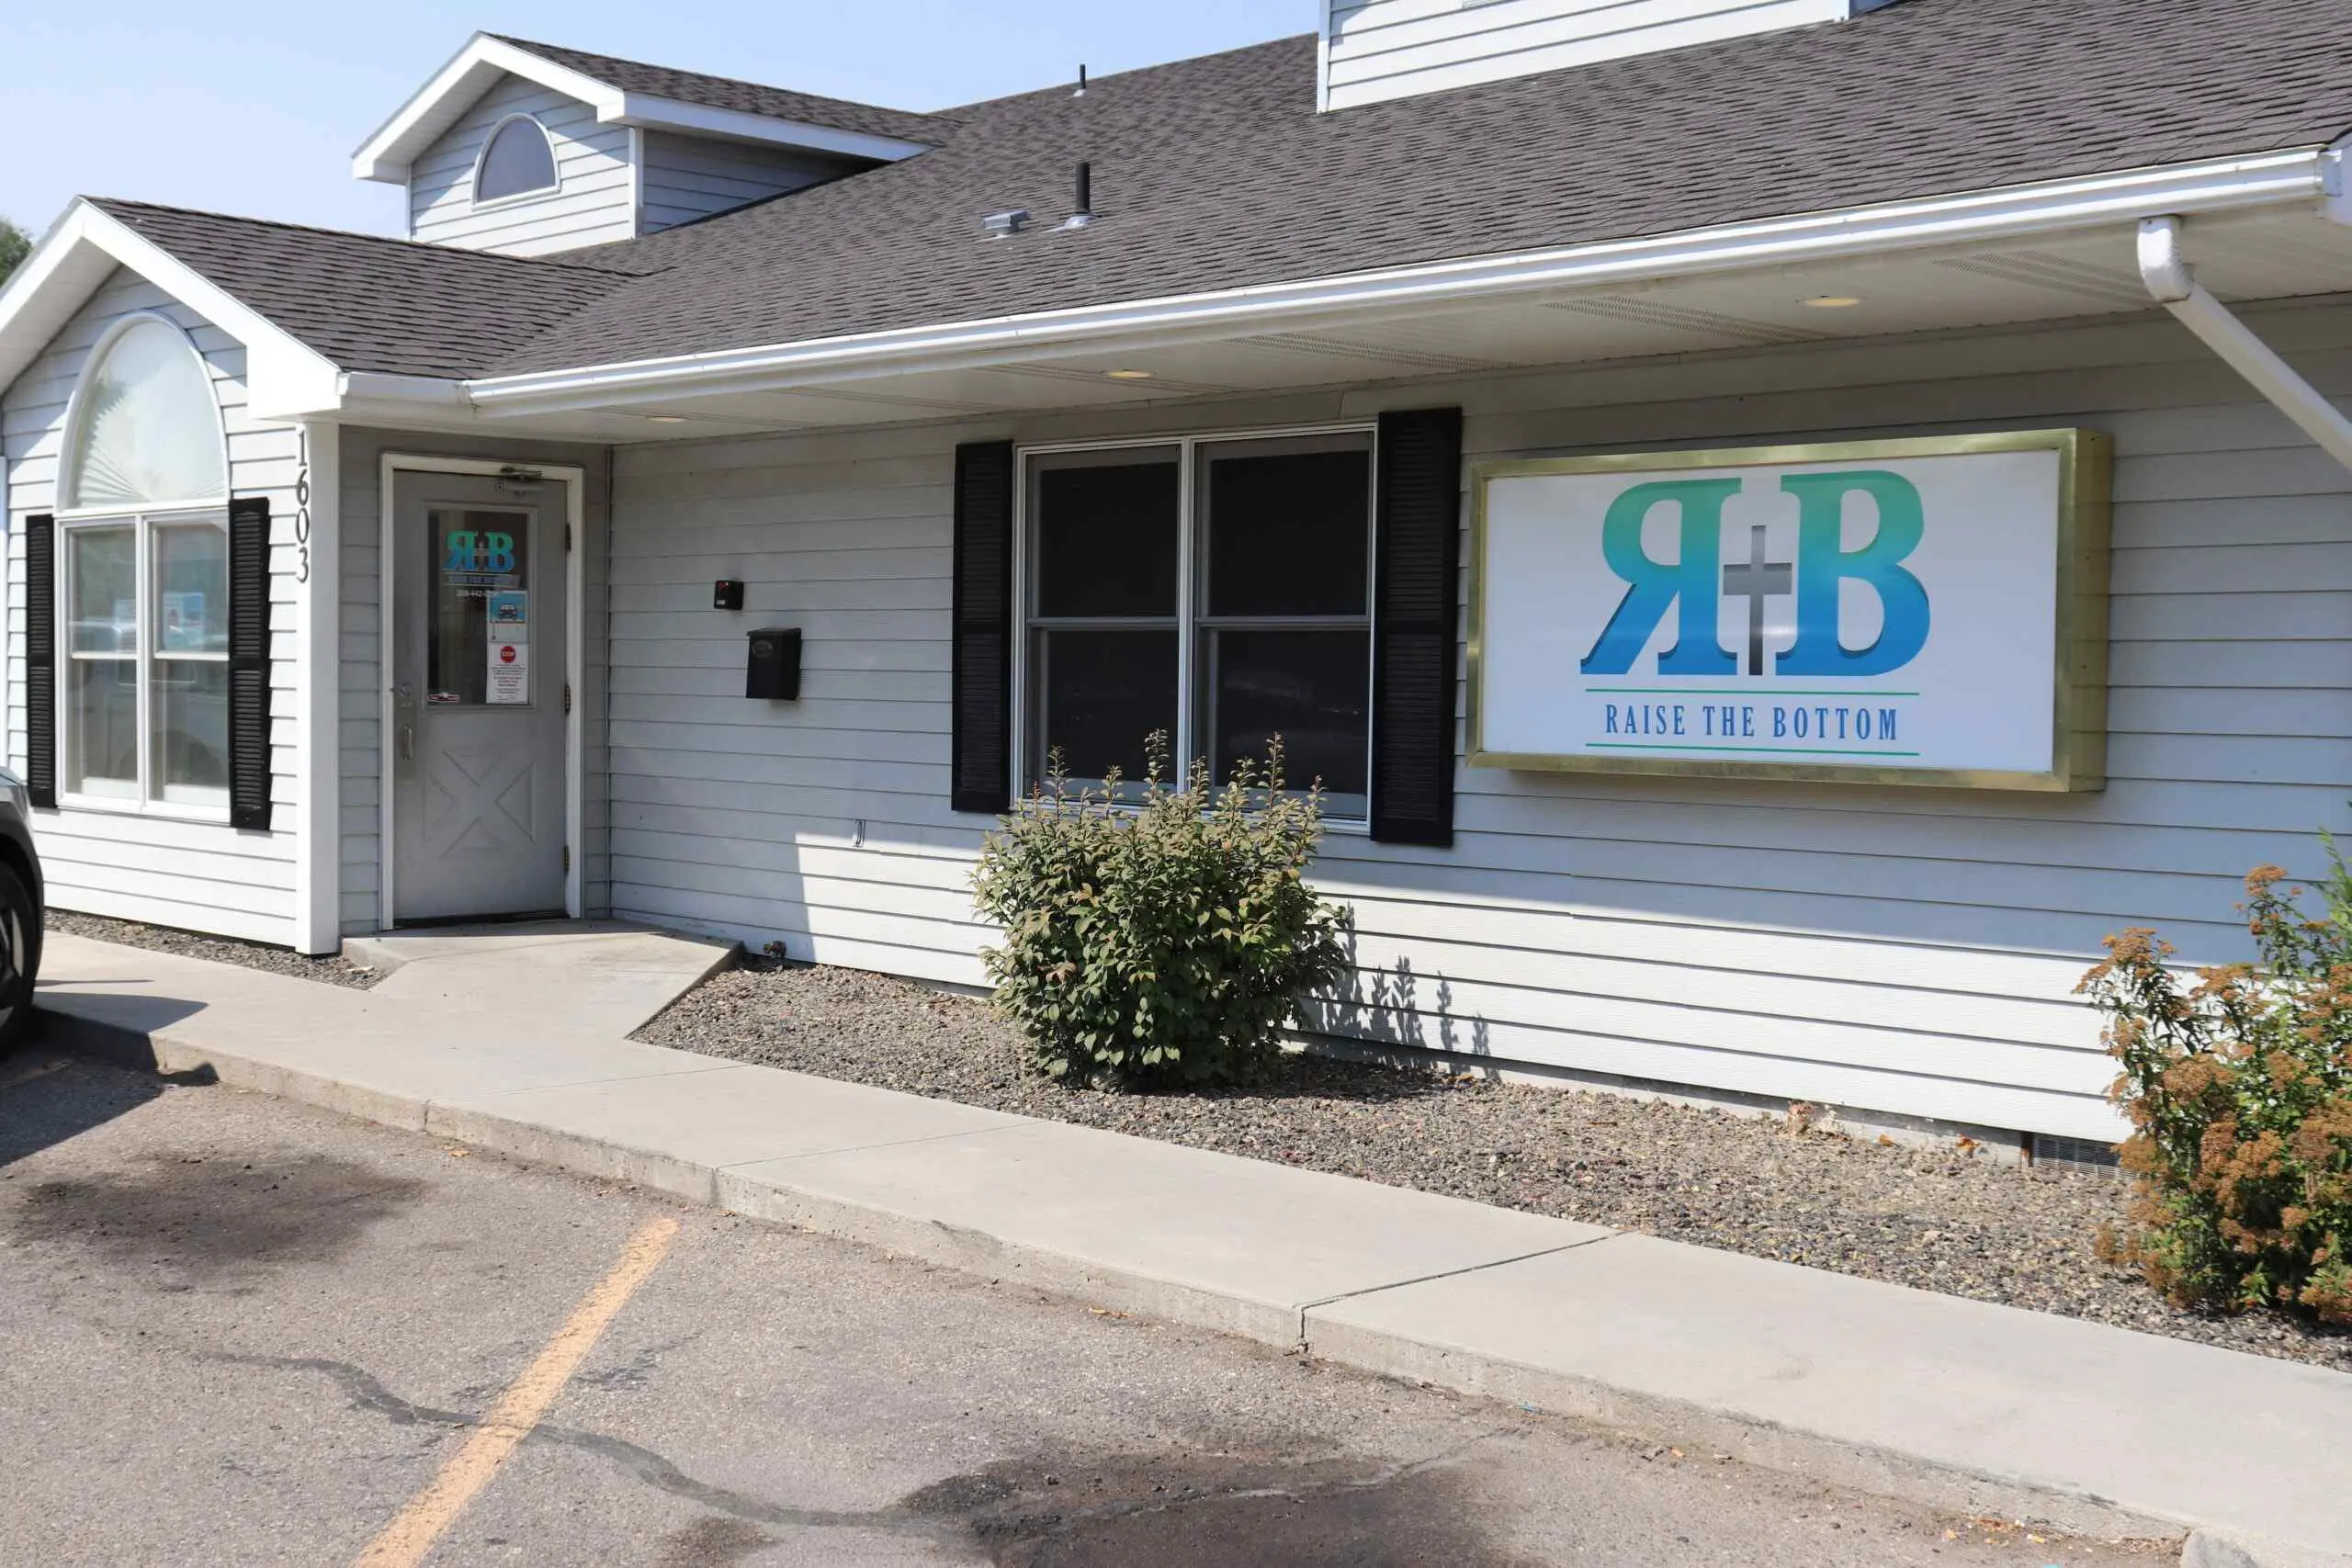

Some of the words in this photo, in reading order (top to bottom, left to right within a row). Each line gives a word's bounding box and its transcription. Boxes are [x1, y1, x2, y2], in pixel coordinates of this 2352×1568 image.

[296, 429, 310, 583] 1603
[1605, 705, 1685, 735] RAISE
[1702, 705, 1754, 737] THE
[1772, 706, 1897, 740] BOTTOM
